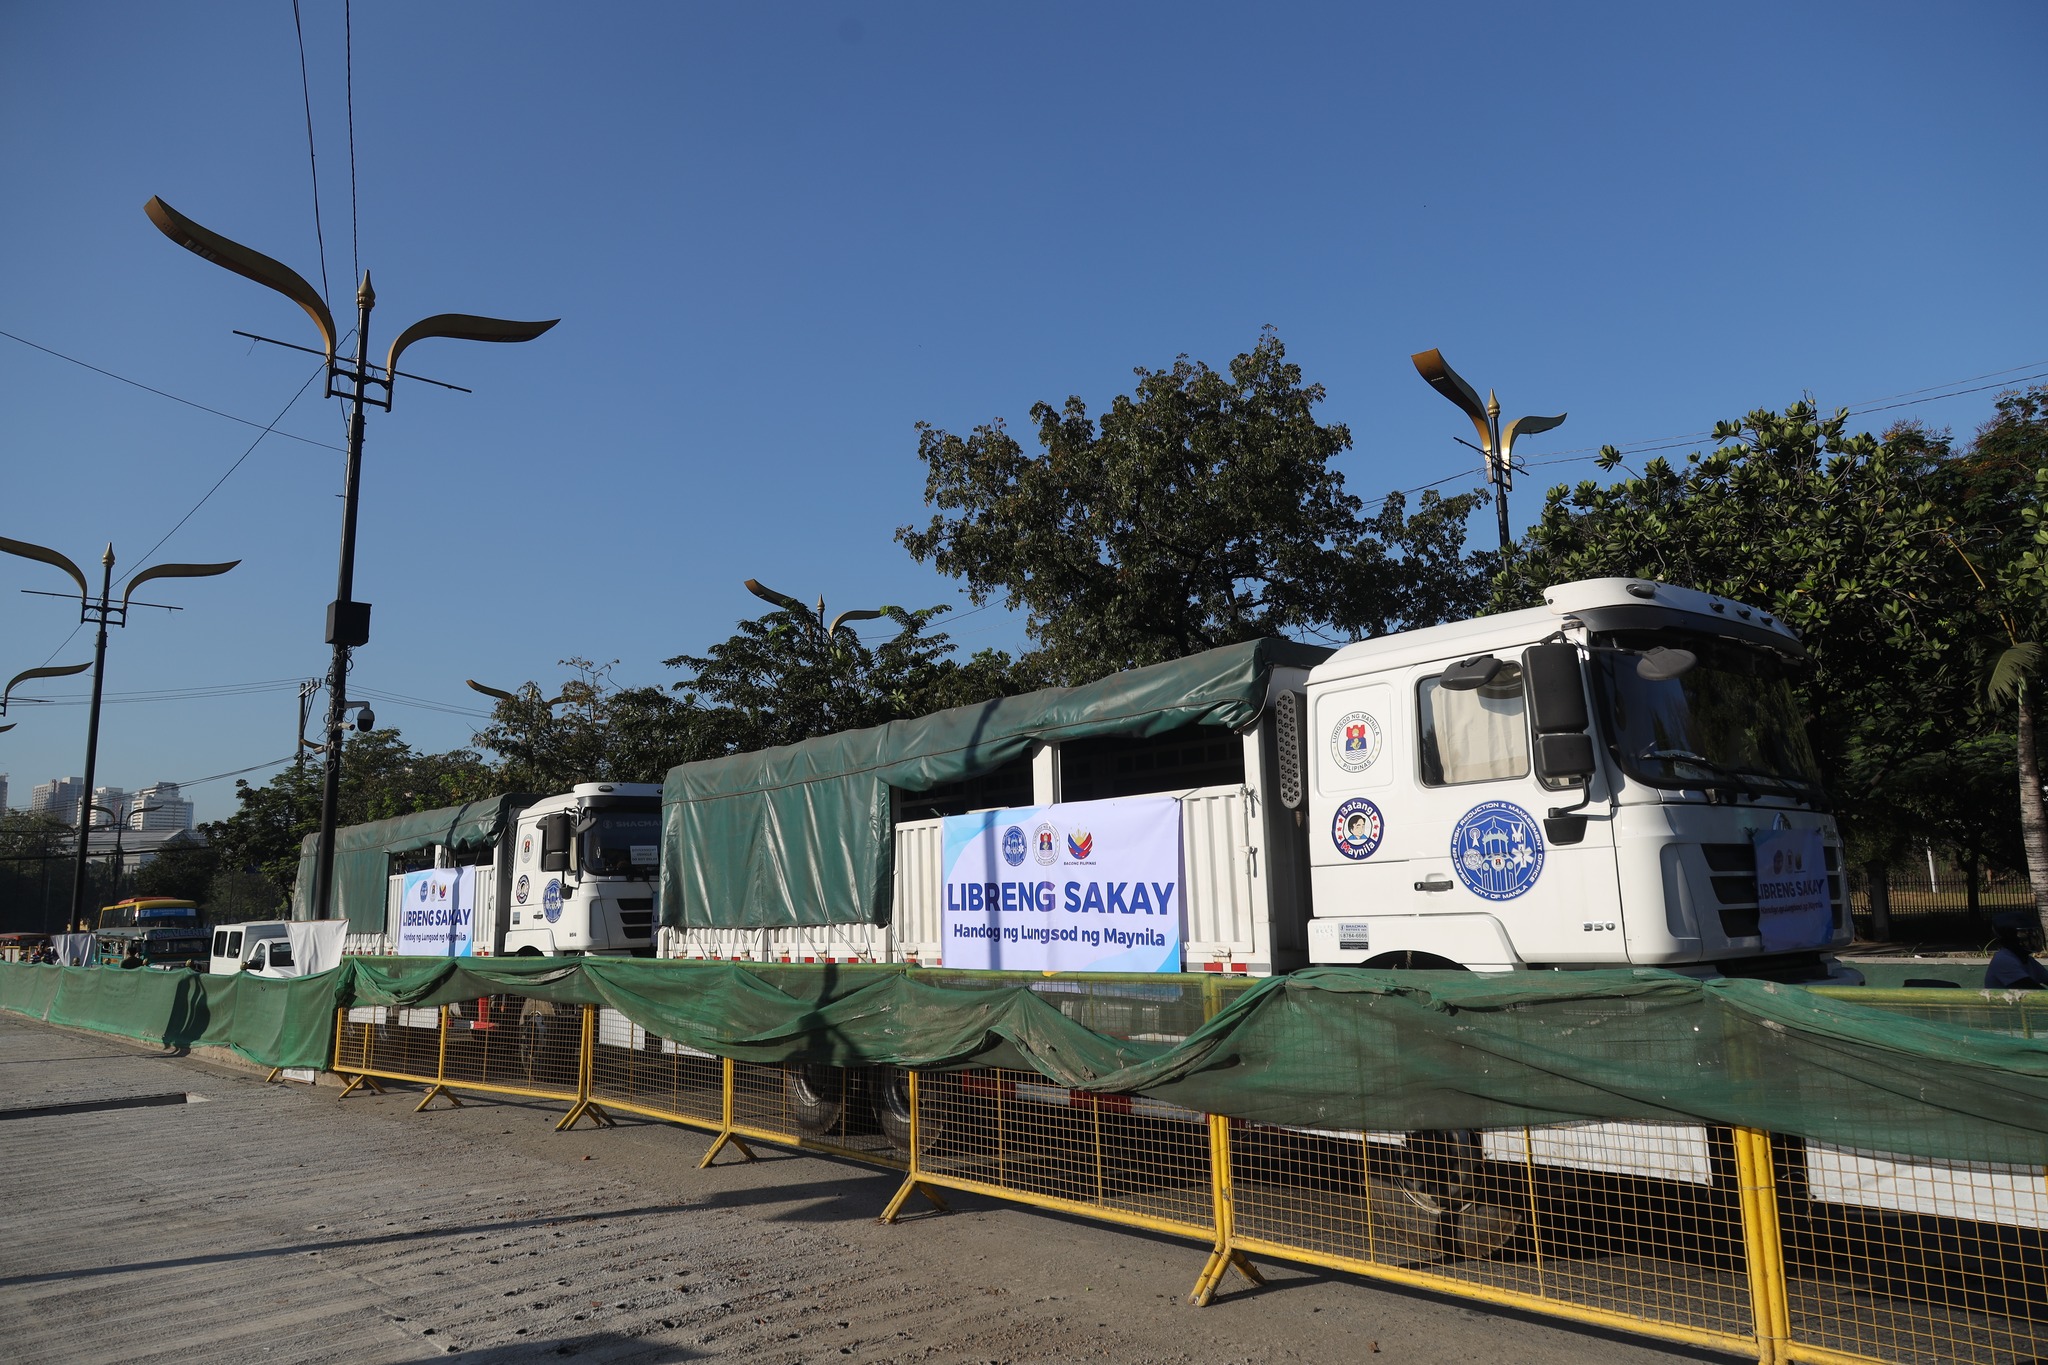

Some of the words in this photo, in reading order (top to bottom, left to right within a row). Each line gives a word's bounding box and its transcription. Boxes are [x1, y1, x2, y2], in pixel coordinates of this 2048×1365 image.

[1332, 716, 1351, 744] LUNGSOD
[1361, 713, 1380, 737] MAYNILA
[1342, 760, 1372, 772] PILIPINAS
[1341, 801, 1374, 816] Batang
[1460, 802, 1499, 826] REDUCTION
[1453, 827, 1461, 846] RISK
[1508, 804, 1542, 851] MANAGEMENT
[1340, 841, 1375, 859] Maynila
[1452, 847, 1471, 885] DISASTER
[1529, 853, 1543, 883] OFFICE
[1473, 886, 1489, 897] CITY
[1502, 885, 1529, 899] MANILA
[1796, 879, 1825, 897] SAKAY
[947, 881, 1056, 913] LIBRENG
[1064, 881, 1175, 915] SAKAY
[403, 909, 434, 927] LIBRENG
[435, 908, 472, 926] SAKAY
[1583, 921, 1616, 932] 350
[421, 932, 438, 943] Lungsod
[439, 933, 445, 943] ng
[445, 932, 467, 943] Maynila
[953, 923, 1001, 943] Handog
[1003, 927, 1019, 943] ng
[1021, 924, 1078, 945] Lungsod
[1081, 929, 1100, 947] ng
[1104, 927, 1166, 949] Maynila
